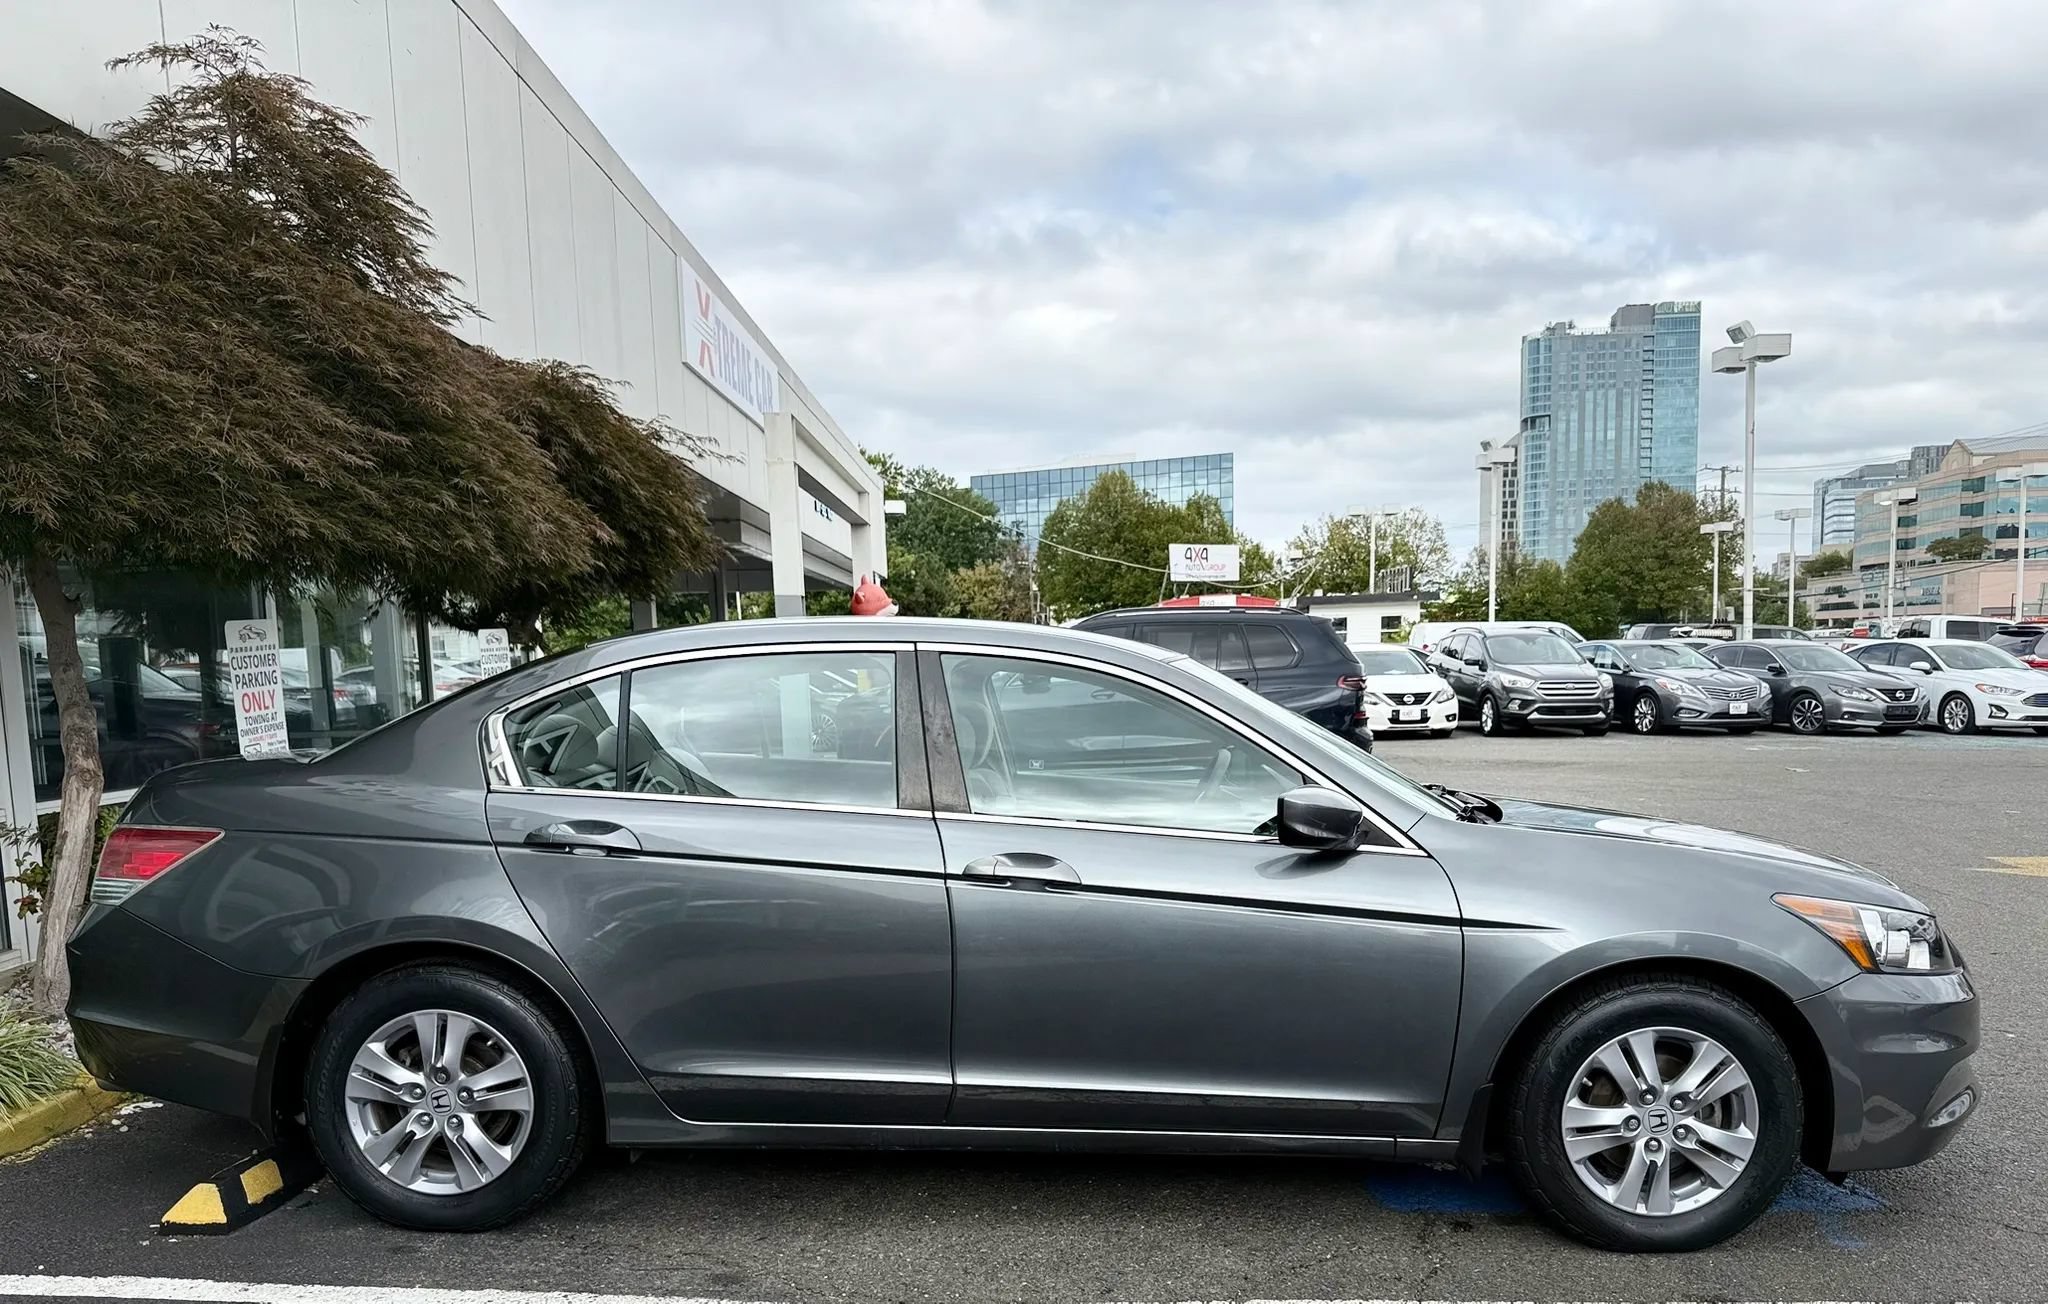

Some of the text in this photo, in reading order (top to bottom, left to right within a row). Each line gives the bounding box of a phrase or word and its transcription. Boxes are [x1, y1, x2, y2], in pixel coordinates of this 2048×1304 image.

[754, 357, 773, 415] CAR
[231, 653, 278, 671] CUSTOMER
[481, 653, 509, 665] CUSTOMER
[235, 670, 278, 690] PARKING
[241, 689, 276, 713] ONLY
[244, 712, 278, 726] TOWING AT
[240, 721, 285, 738] OWNER'S EXPENSE
